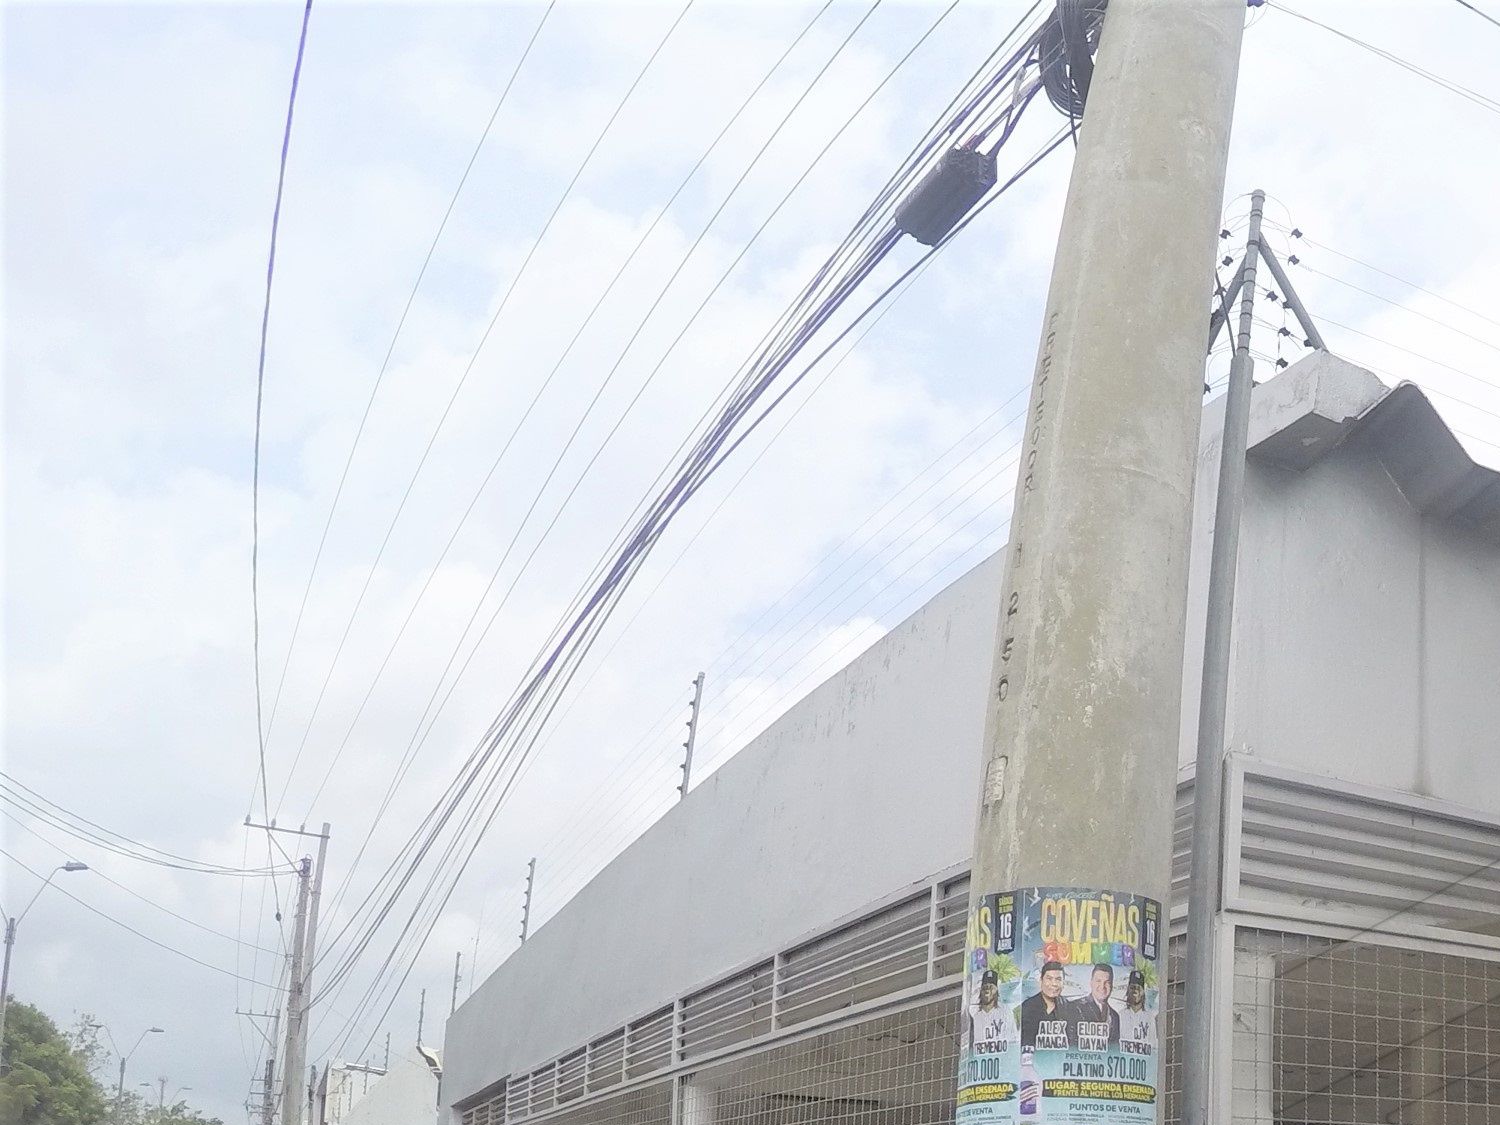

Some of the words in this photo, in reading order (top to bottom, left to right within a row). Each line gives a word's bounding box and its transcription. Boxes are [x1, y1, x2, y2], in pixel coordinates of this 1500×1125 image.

[1000, 913, 1012, 939] 16
[1041, 895, 1140, 947] COVEÑAS
[1146, 919, 1155, 945] 16
[1039, 1022, 1067, 1035] ALEX
[1078, 1022, 1108, 1036] ELDER
[974, 1040, 1007, 1053] TREMENDO
[1037, 1035, 1068, 1049] MANGA
[1079, 1037, 1106, 1050] DAYAN
[1063, 1062, 1104, 1078] PLATINO
[1107, 1056, 1147, 1081] $70.000
[1045, 1082, 1078, 1090] LUGAR:
[1081, 1083, 1121, 1092] SEGUNDA
[1070, 1104, 1100, 1112] PUNTOS
[1103, 1104, 1116, 1112] DE
[1118, 1105, 1140, 1114] VENTA
